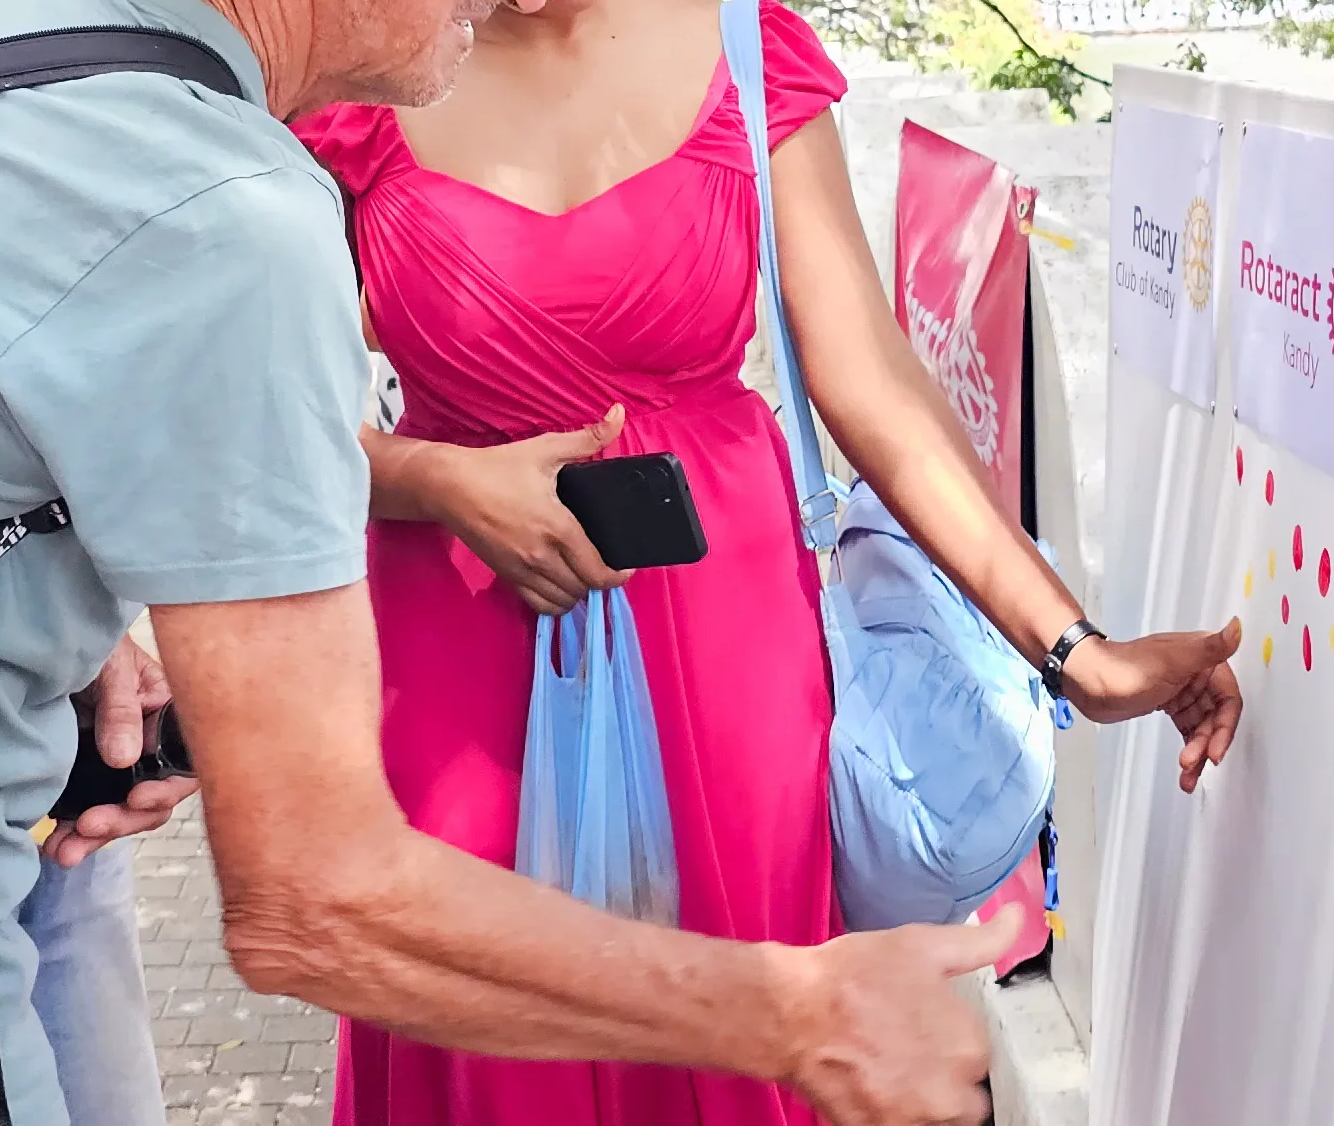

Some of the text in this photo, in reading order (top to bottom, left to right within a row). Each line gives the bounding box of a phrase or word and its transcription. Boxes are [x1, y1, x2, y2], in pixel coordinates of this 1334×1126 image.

[1133, 205, 1177, 274] Rotary
[1115, 261, 1176, 319] Club of Kandy
[1240, 240, 1321, 322] Rotaract
[1283, 330, 1319, 389] Kandy
